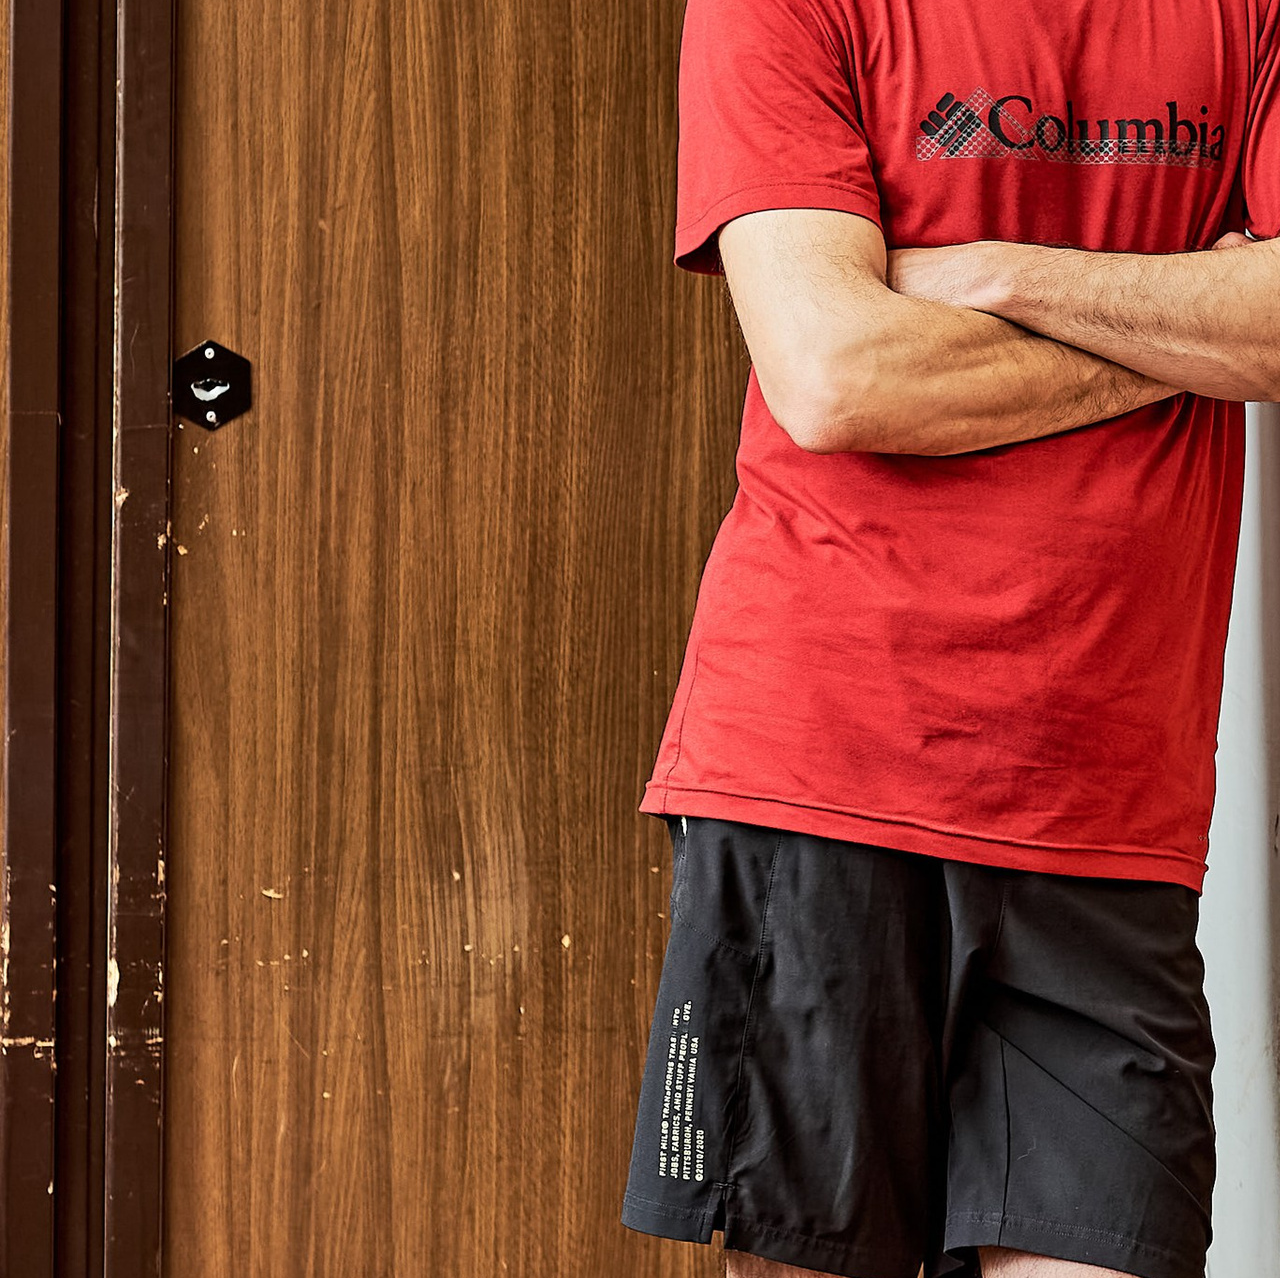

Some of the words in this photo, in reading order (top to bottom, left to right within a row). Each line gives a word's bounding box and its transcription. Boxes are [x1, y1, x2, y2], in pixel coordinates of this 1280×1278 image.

[988, 95, 1226, 161] Columbia
[675, 1063, 685, 1091] STUFF
[674, 1092, 682, 1111] AND
[683, 1124, 693, 1180] PITTSBURGH,
[691, 1037, 699, 1054] USA
[672, 1113, 682, 1151] FABRICS,
[659, 1151, 667, 1176] FIRST
[671, 1154, 680, 1178] JOBS,
